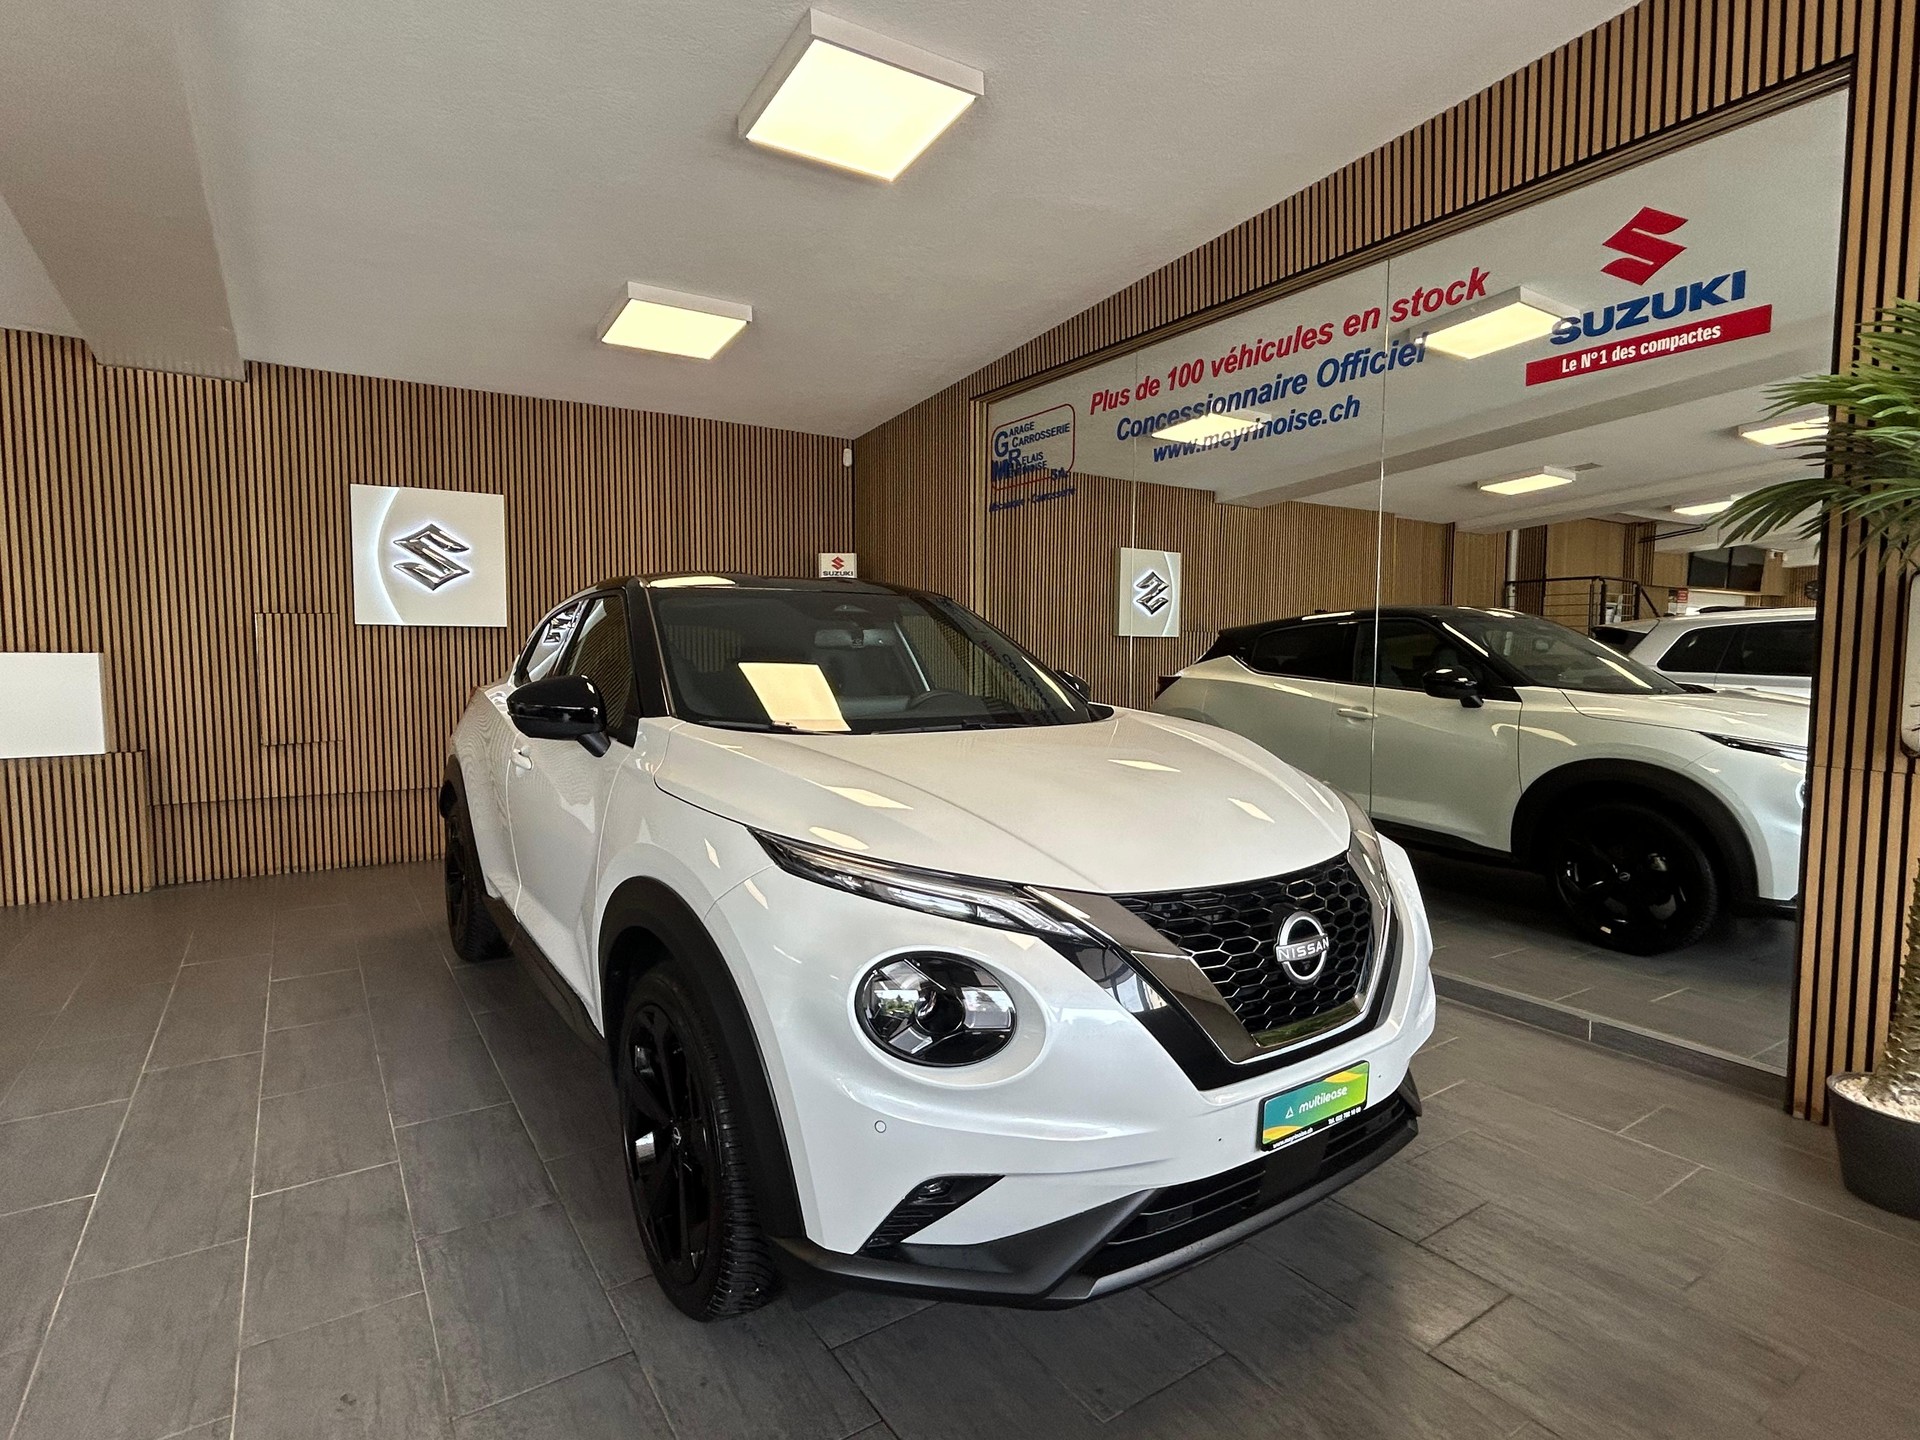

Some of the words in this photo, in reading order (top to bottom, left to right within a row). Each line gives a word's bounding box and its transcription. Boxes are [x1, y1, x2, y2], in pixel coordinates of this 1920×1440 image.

[1549, 269, 1747, 346] SUZUKI
[1090, 388, 1131, 415] Plus
[1135, 375, 1160, 401] de
[1167, 358, 1205, 391] 100
[1211, 322, 1335, 378] véhicules
[1343, 307, 1381, 337] en
[1390, 266, 1491, 323] stock
[1561, 358, 1577, 374] Le
[1611, 345, 1636, 362] des
[1640, 325, 1722, 355] compactes
[1117, 373, 1308, 441] Concessionnaire
[1316, 331, 1430, 388] Officiel
[994, 421, 1035, 458] GARAGE
[1011, 423, 1071, 448] CARROSSERIE
[1153, 394, 1361, 462] www.meyrinoise.ch
[1279, 936, 1330, 960] NISSAN
[1298, 1085, 1348, 1114] multilease
